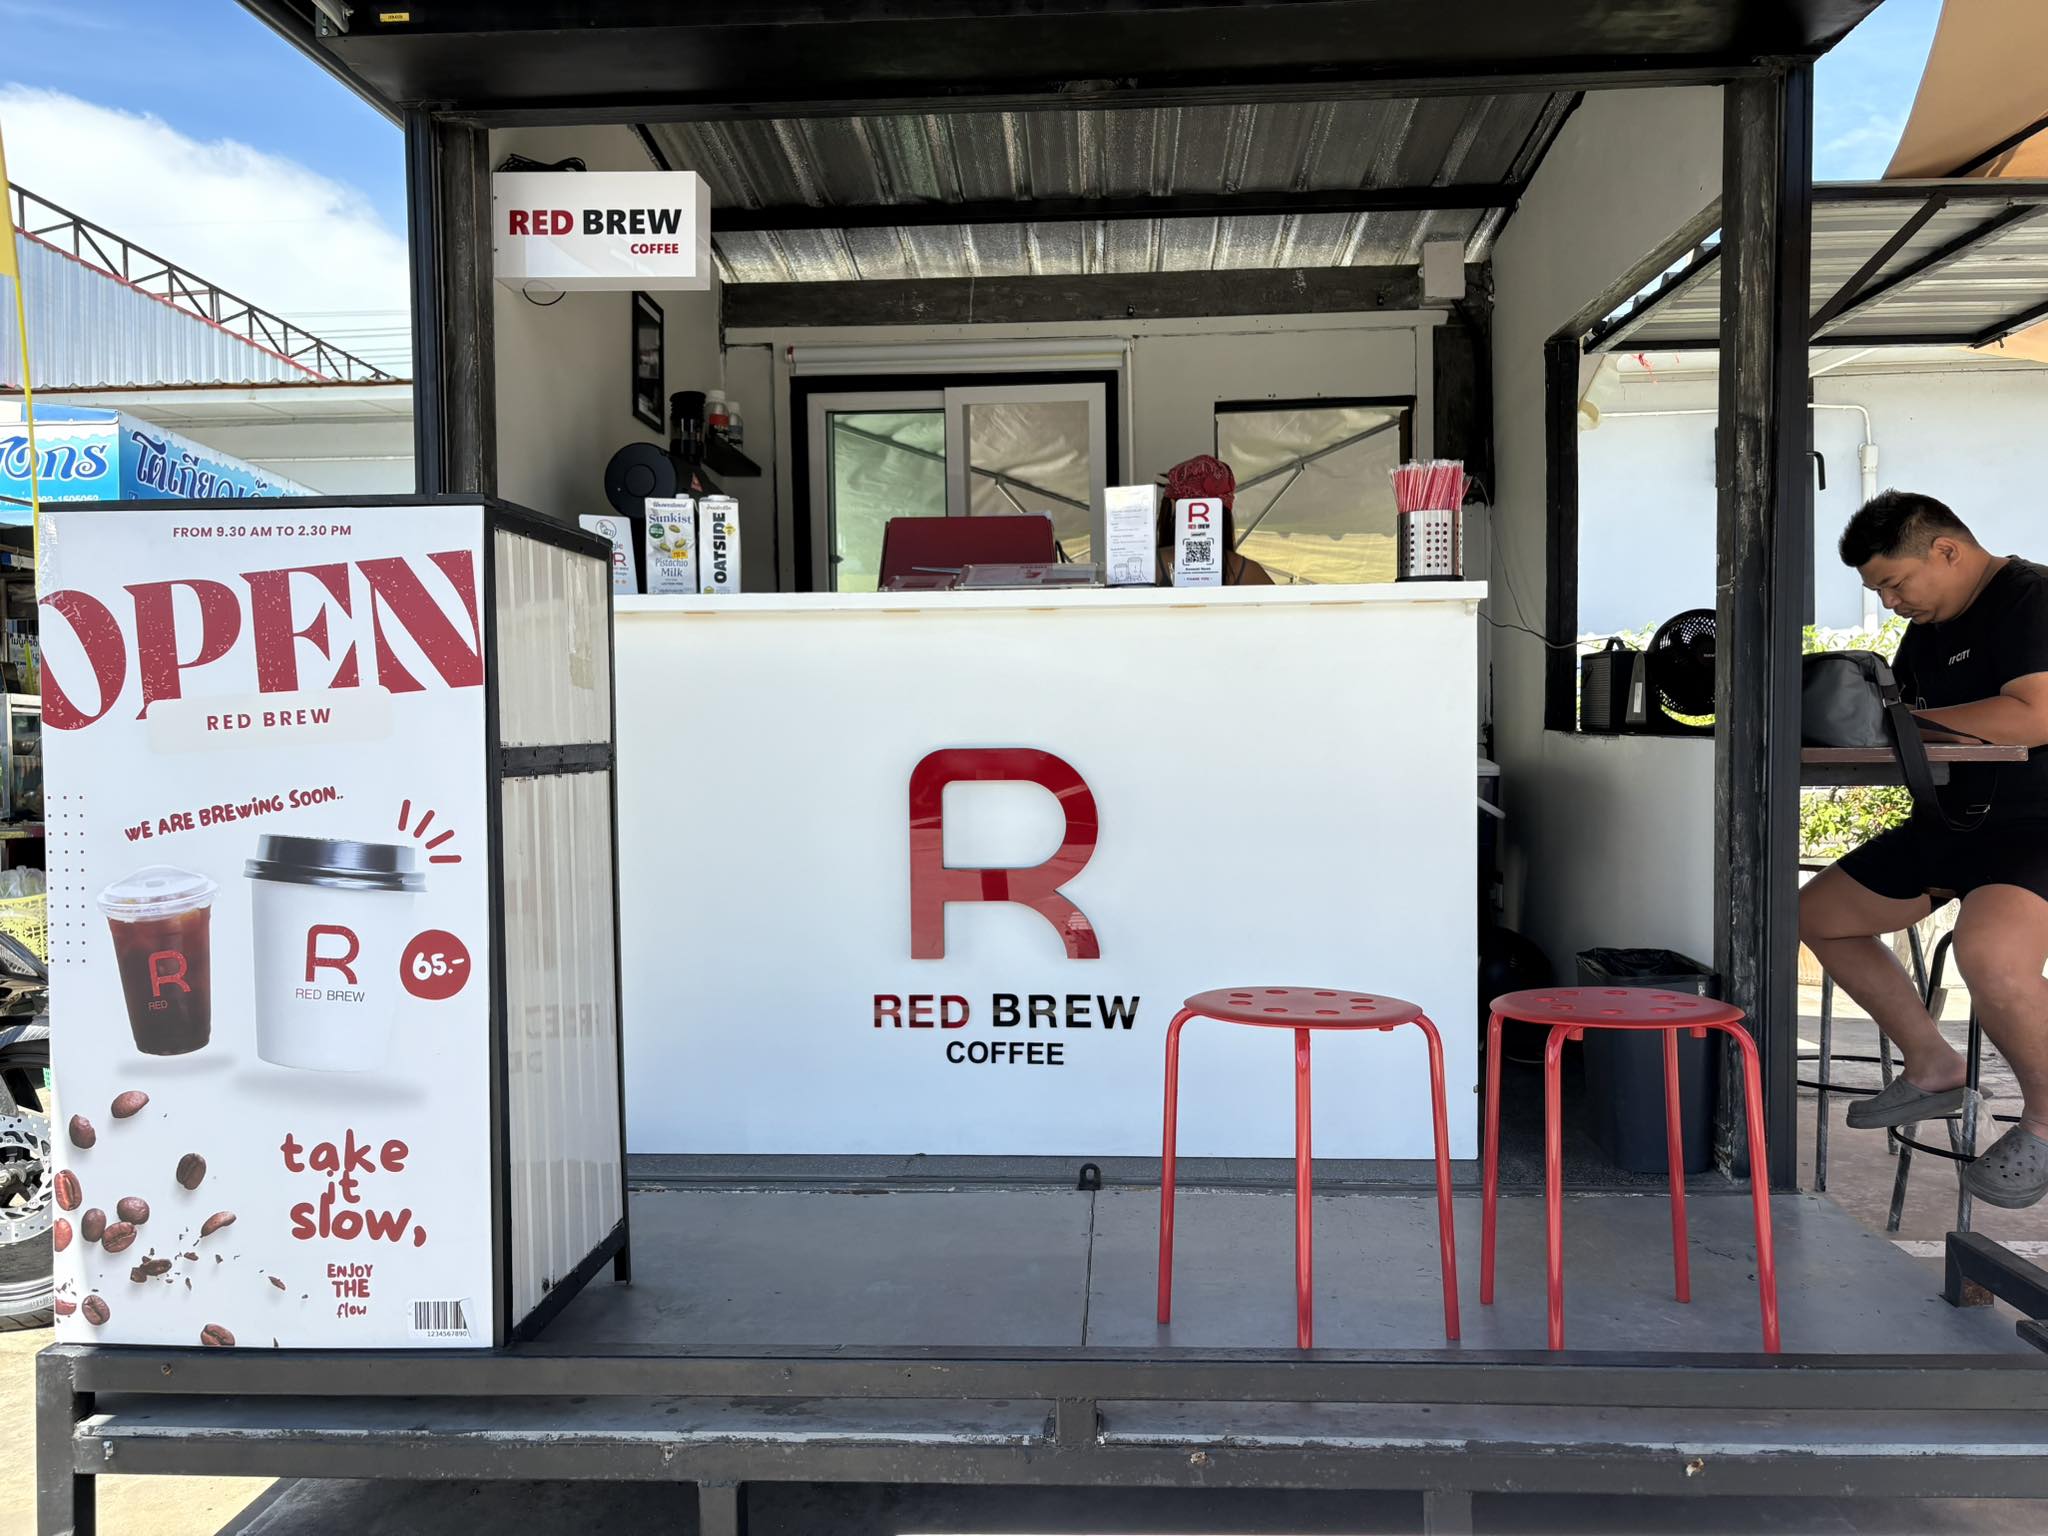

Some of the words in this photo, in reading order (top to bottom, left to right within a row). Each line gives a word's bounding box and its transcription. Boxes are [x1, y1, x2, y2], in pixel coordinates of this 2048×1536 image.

[509, 209, 574, 236] RED
[583, 208, 682, 235] BREW
[630, 243, 679, 254] COFFEE
[649, 513, 692, 524] Sunkist
[1187, 502, 1210, 522] R
[172, 525, 212, 538] FROM
[216, 525, 247, 538] 9.30
[250, 525, 273, 537] AM
[276, 525, 295, 537] TO
[298, 525, 328, 537] 2.30
[331, 524, 352, 536] PM
[712, 512, 727, 584] OATSIDE
[655, 557, 689, 567] Pistachio
[661, 568, 683, 577] Milk
[40, 549, 484, 732] OPEN
[207, 712, 252, 731] RED
[262, 708, 332, 728] BREW
[158, 813, 195, 836] ARE
[909, 747, 1101, 960] R
[305, 924, 360, 985] R
[411, 951, 466, 981] 65.-
[149, 949, 192, 998] R
[295, 988, 322, 1001] RED
[326, 988, 365, 1002] BREW
[874, 994, 970, 1029] RED
[992, 993, 1141, 1030] BREW
[946, 1040, 1064, 1066] COFFEE
[280, 1128, 410, 1174] take
[326, 1168, 361, 1204] it
[290, 1192, 427, 1247] slow,
[327, 1263, 373, 1279] ENJOY
[331, 1278, 370, 1298] THE
[336, 1302, 367, 1319] flow
